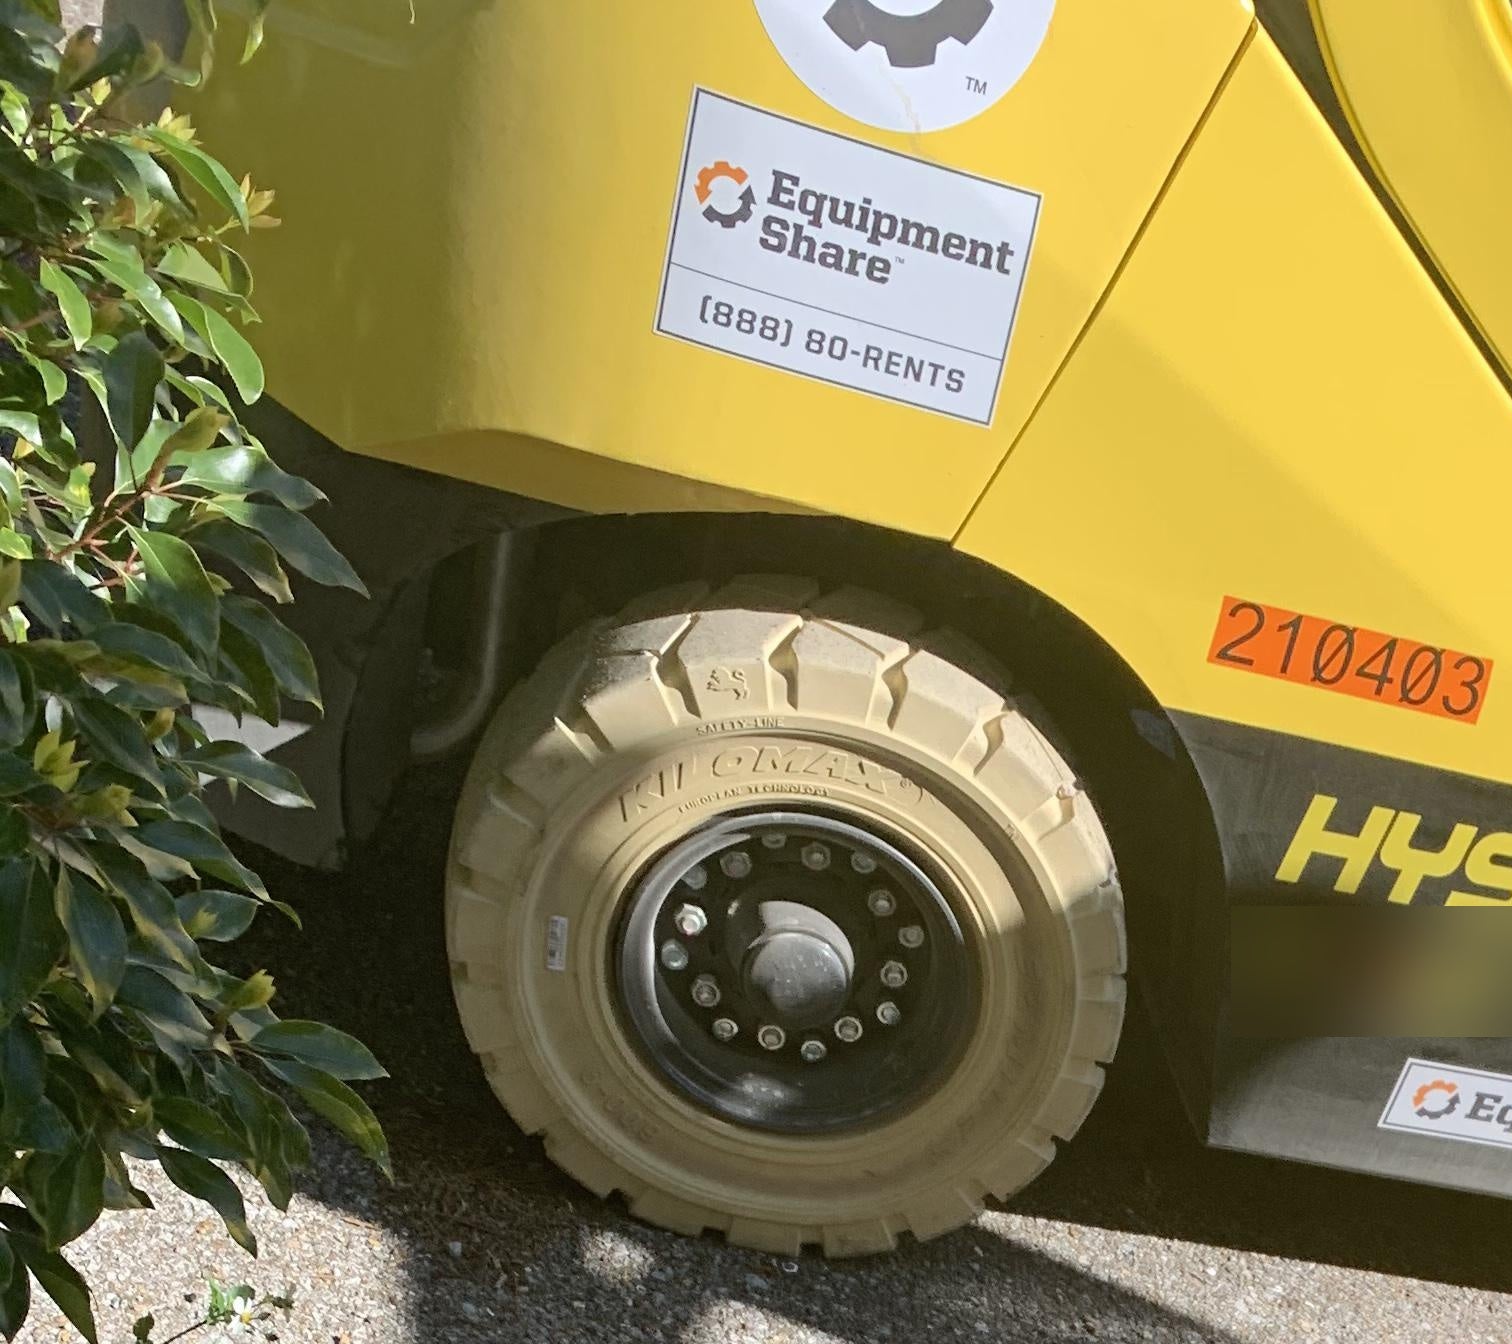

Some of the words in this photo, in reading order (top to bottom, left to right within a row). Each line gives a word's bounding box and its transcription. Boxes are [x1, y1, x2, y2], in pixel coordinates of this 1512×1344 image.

[759, 215, 892, 284] Share
[767, 169, 1014, 275] Equipment
[699, 295, 793, 347] (888)
[805, 328, 966, 393] 80-RENTS
[1215, 601, 1487, 716] 210403
